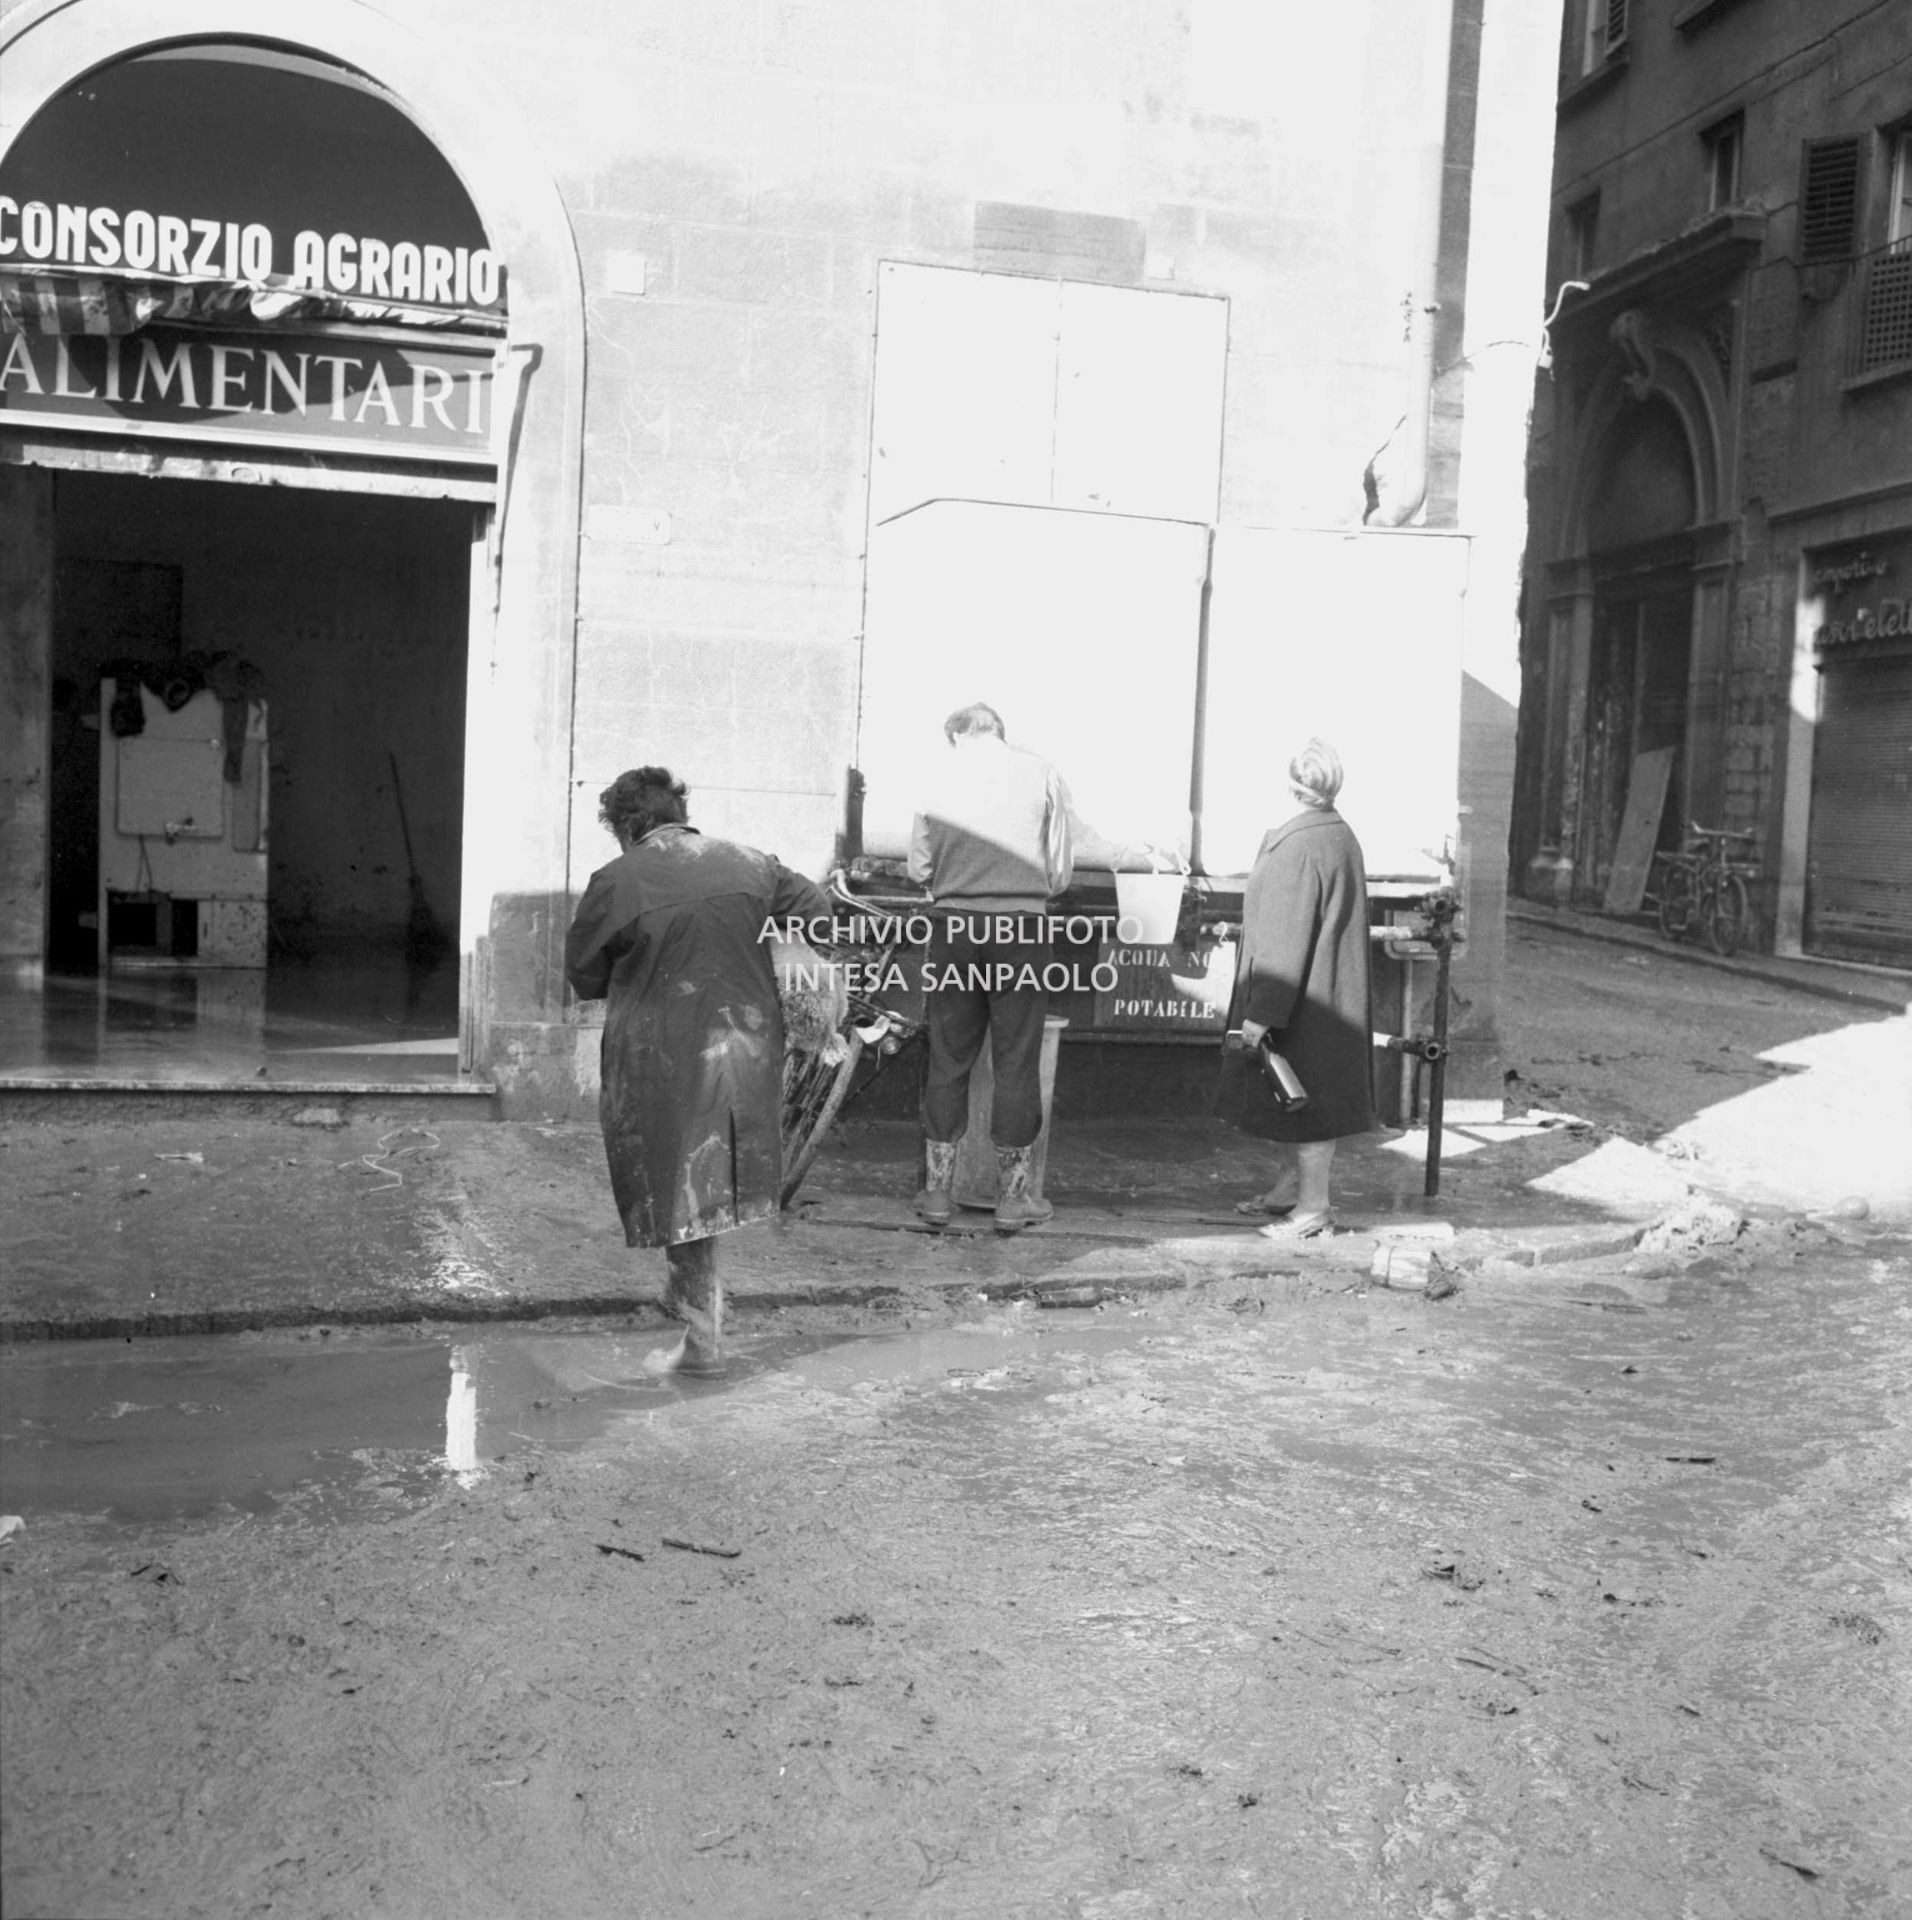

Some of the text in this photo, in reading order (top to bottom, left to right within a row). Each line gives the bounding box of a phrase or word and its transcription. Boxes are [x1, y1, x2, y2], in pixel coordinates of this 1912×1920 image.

[0, 195, 500, 306] CONSORZIO AGRARIO
[0, 332, 484, 434] ALIMENTARI
[1106, 949, 1211, 969] ACQUA NO
[1114, 999, 1216, 1018] POTABILE
